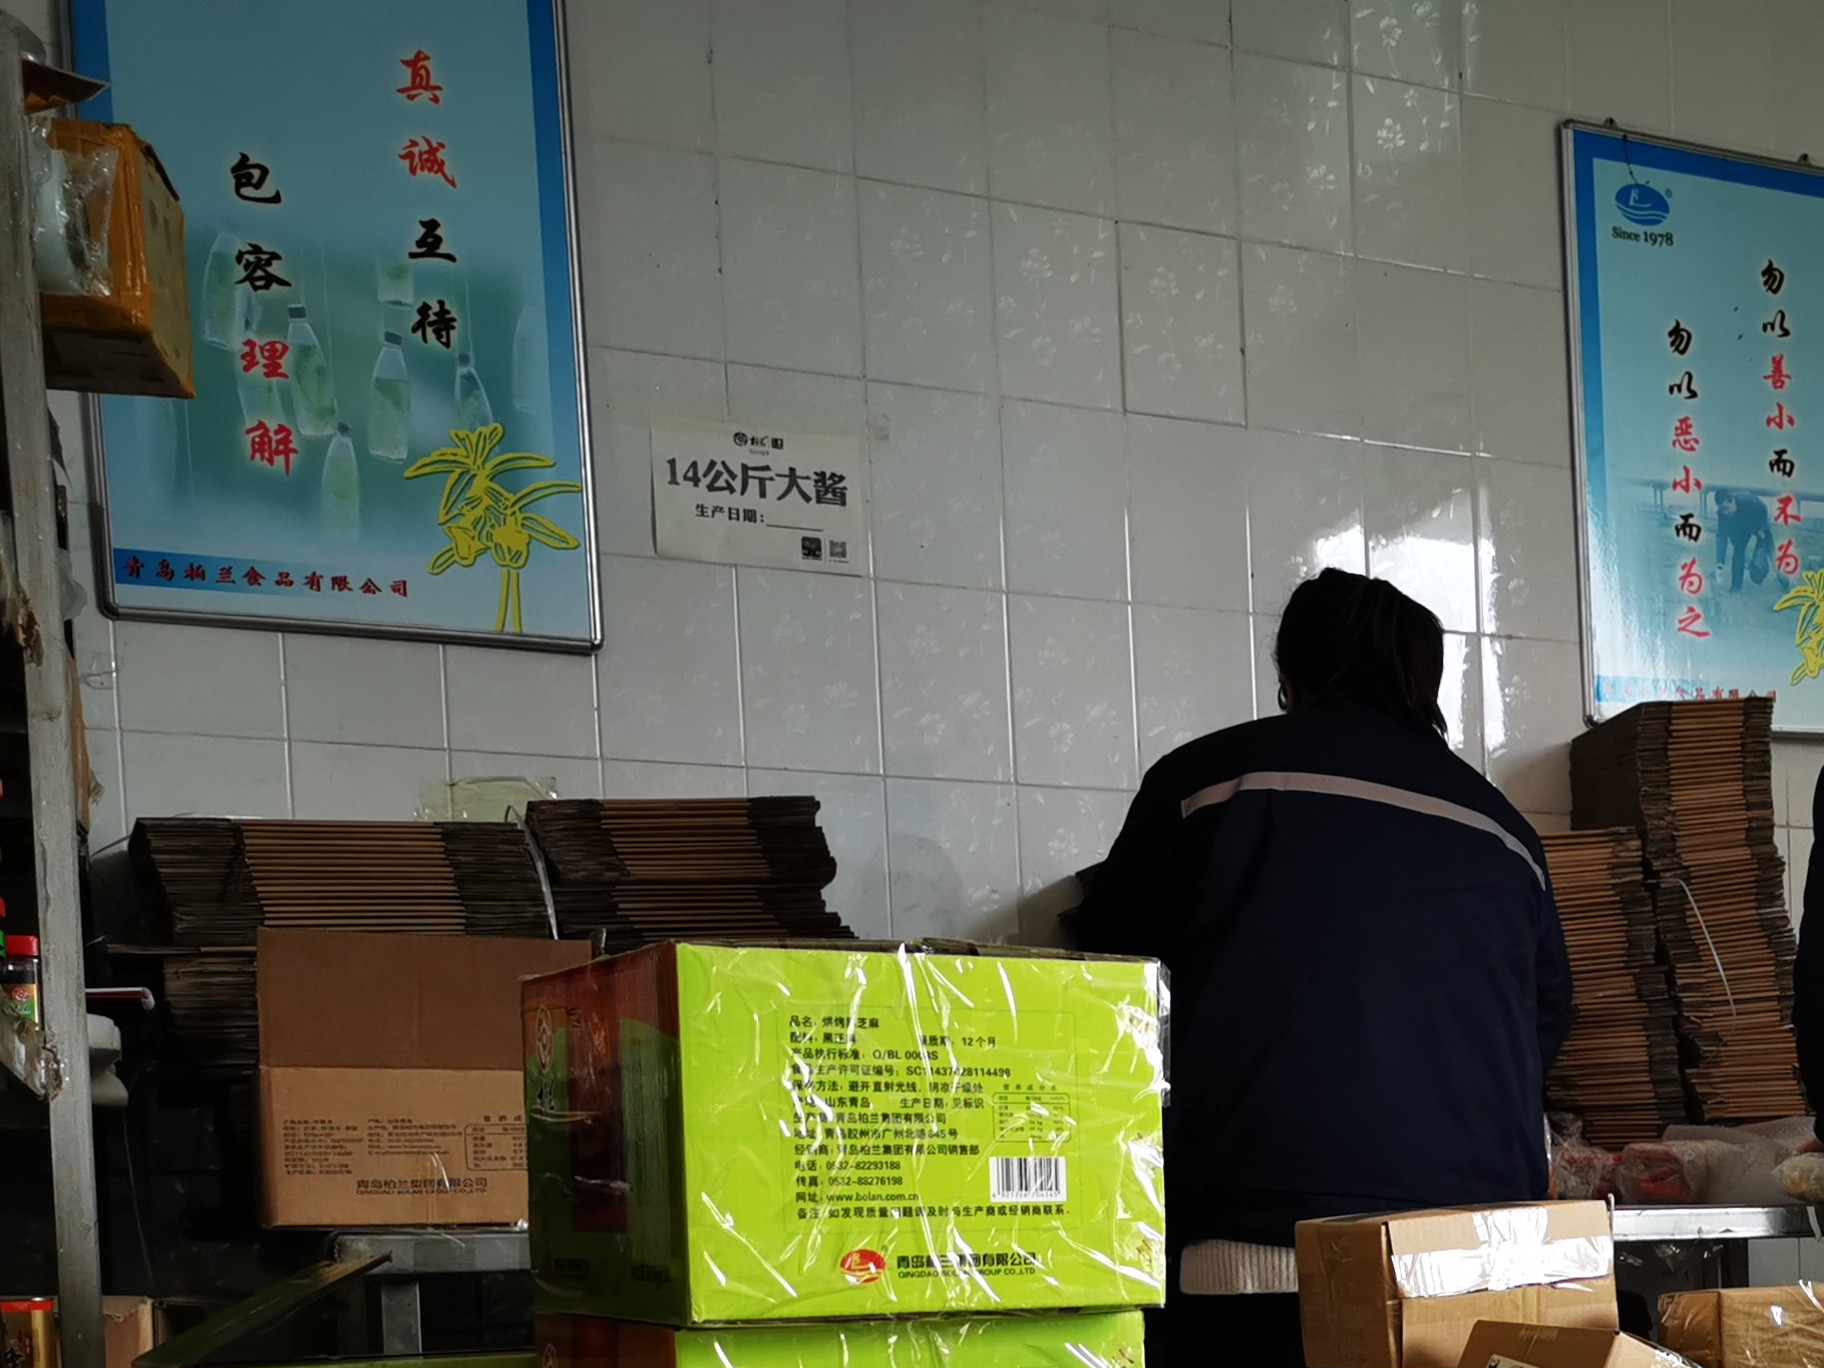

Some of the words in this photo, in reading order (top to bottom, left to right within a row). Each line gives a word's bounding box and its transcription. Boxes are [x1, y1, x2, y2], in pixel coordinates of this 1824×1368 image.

[395, 49, 459, 350] 真诚互待
[1611, 226, 1641, 242] Since
[1643, 230, 1674, 247] 1978
[230, 152, 300, 476] 包容理解
[666, 457, 848, 507] 14公斤大酱
[1667, 319, 1711, 638] 勿以恶小而为之
[1760, 258, 1802, 576] 勿以善小而不为
[122, 555, 408, 597] 青岛柏兰食品有限公司
[872, 1049, 901, 1060] Q/BL
